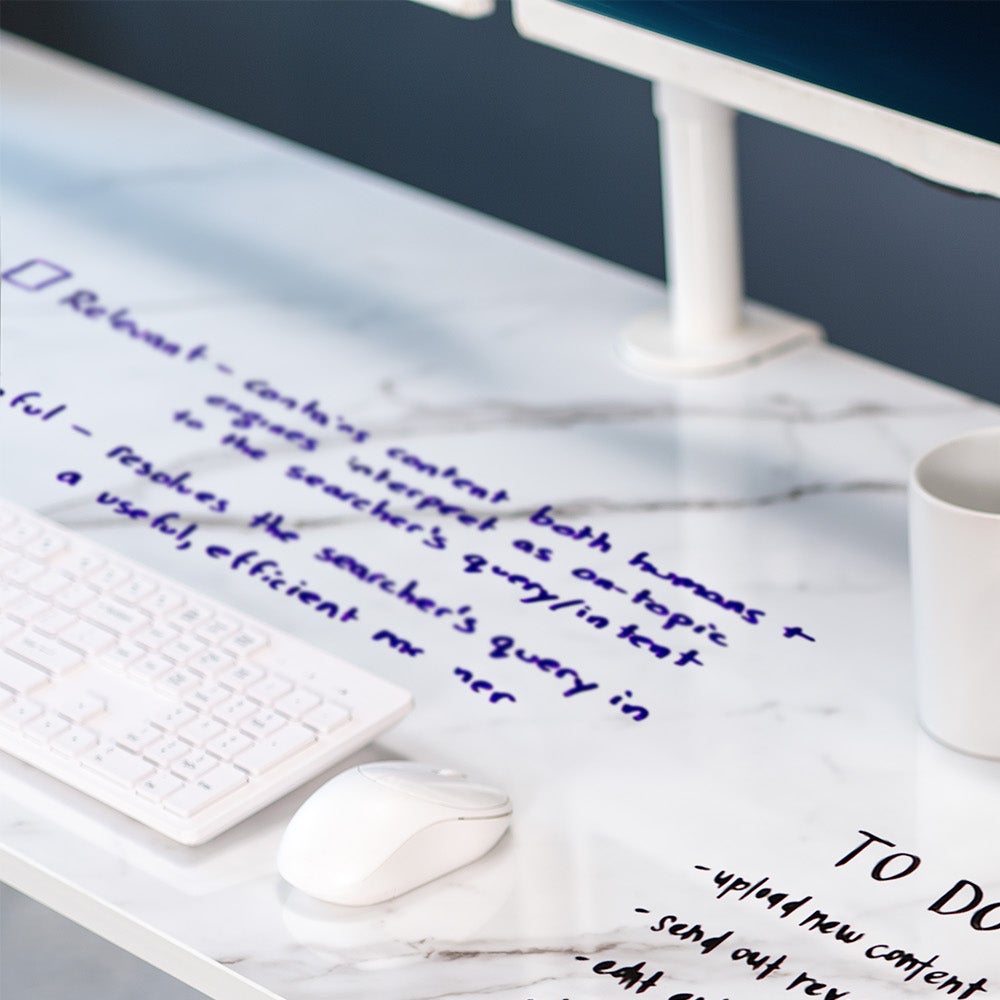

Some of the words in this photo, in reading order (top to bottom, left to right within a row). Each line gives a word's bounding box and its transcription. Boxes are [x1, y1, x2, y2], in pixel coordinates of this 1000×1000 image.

[56, 470, 82, 485] a
[97, 491, 198, 550] useful,
[205, 543, 358, 622] efficient
[386, 447, 509, 503] content
[529, 506, 612, 552] both
[628, 552, 766, 624] humans
[512, 539, 553, 562] as
[107, 445, 229, 513] resolves
[249, 512, 300, 542] the
[489, 635, 599, 697] query
[609, 690, 650, 721] in
[835, 830, 921, 881] TO
[731, 948, 787, 980] out
[799, 910, 865, 943] new
[865, 944, 987, 1000] content
